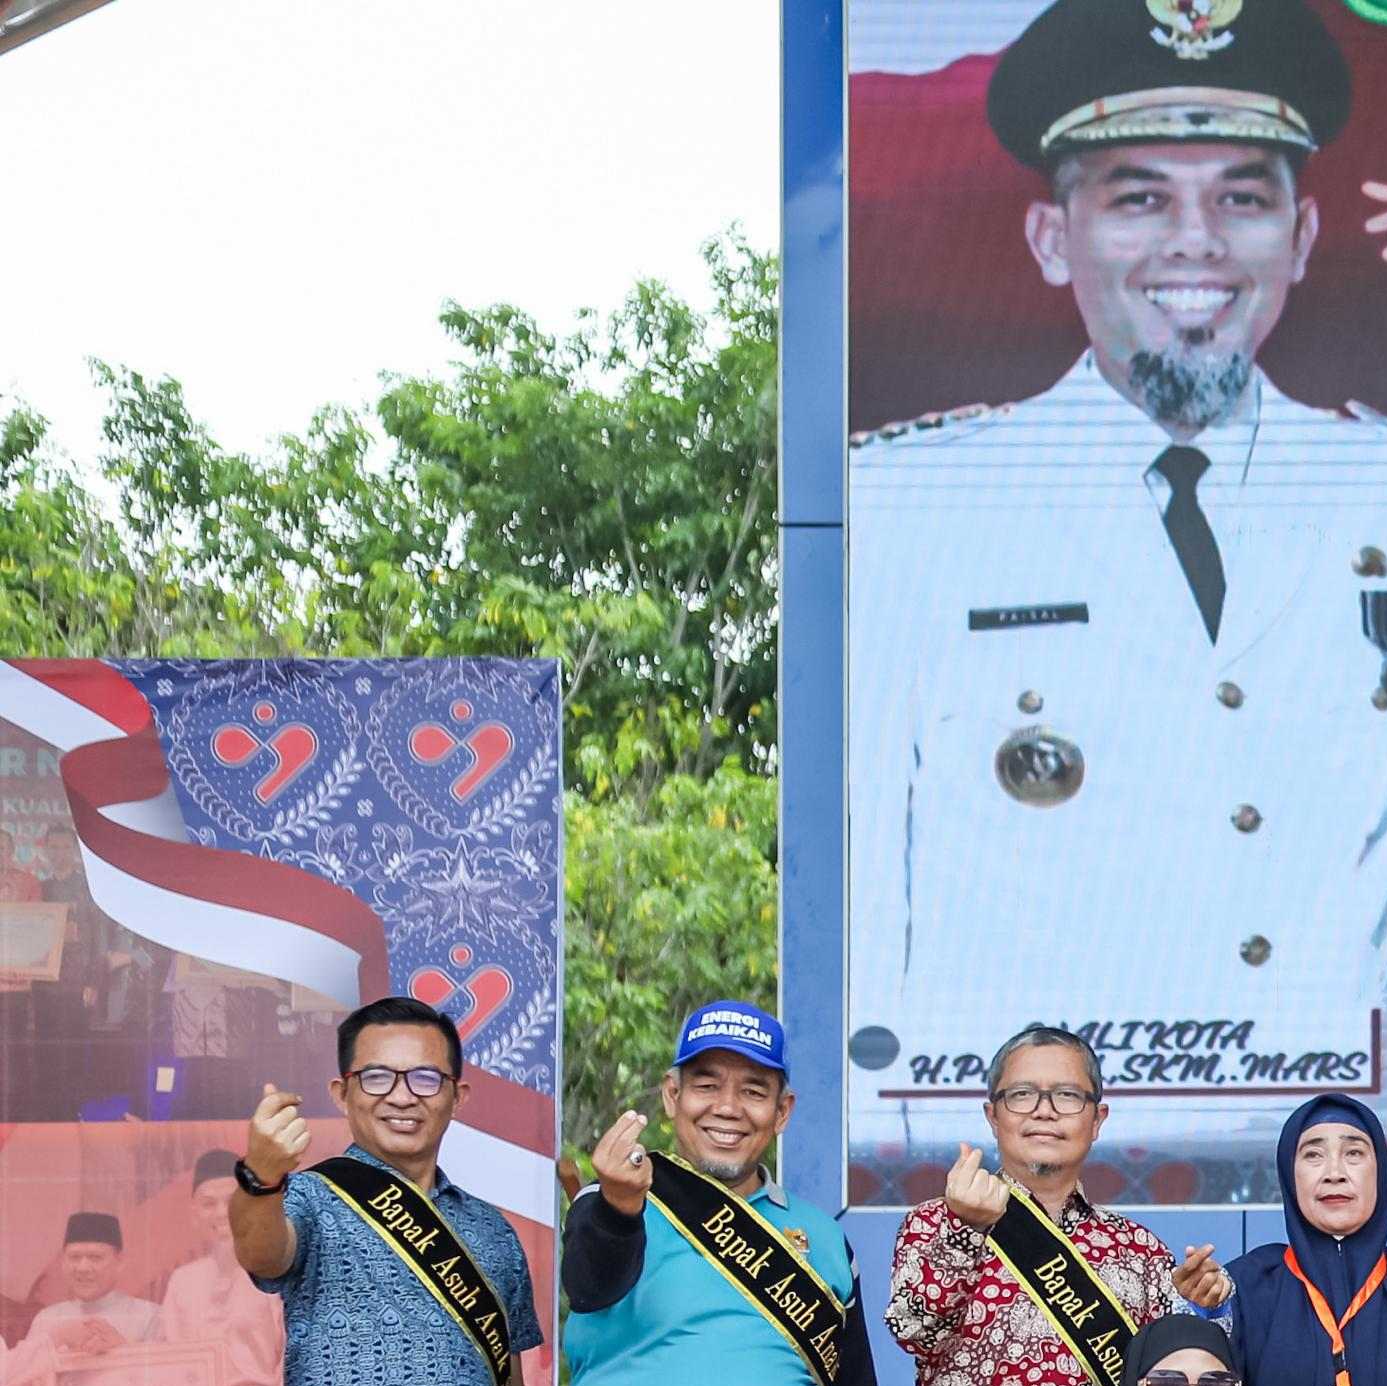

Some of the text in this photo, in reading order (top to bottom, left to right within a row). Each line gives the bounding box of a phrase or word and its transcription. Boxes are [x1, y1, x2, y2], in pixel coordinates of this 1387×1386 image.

[687, 1023, 772, 1046] KEBAIKAN
[700, 1010, 760, 1029] ENERGI
[1028, 1019, 1255, 1051] ALI KOTA
[368, 1183, 512, 1372] Bapak Asuh Anak
[702, 1203, 774, 1280] Bapak
[764, 1272, 822, 1332] Asuh
[1033, 1253, 1100, 1329] Bapak
